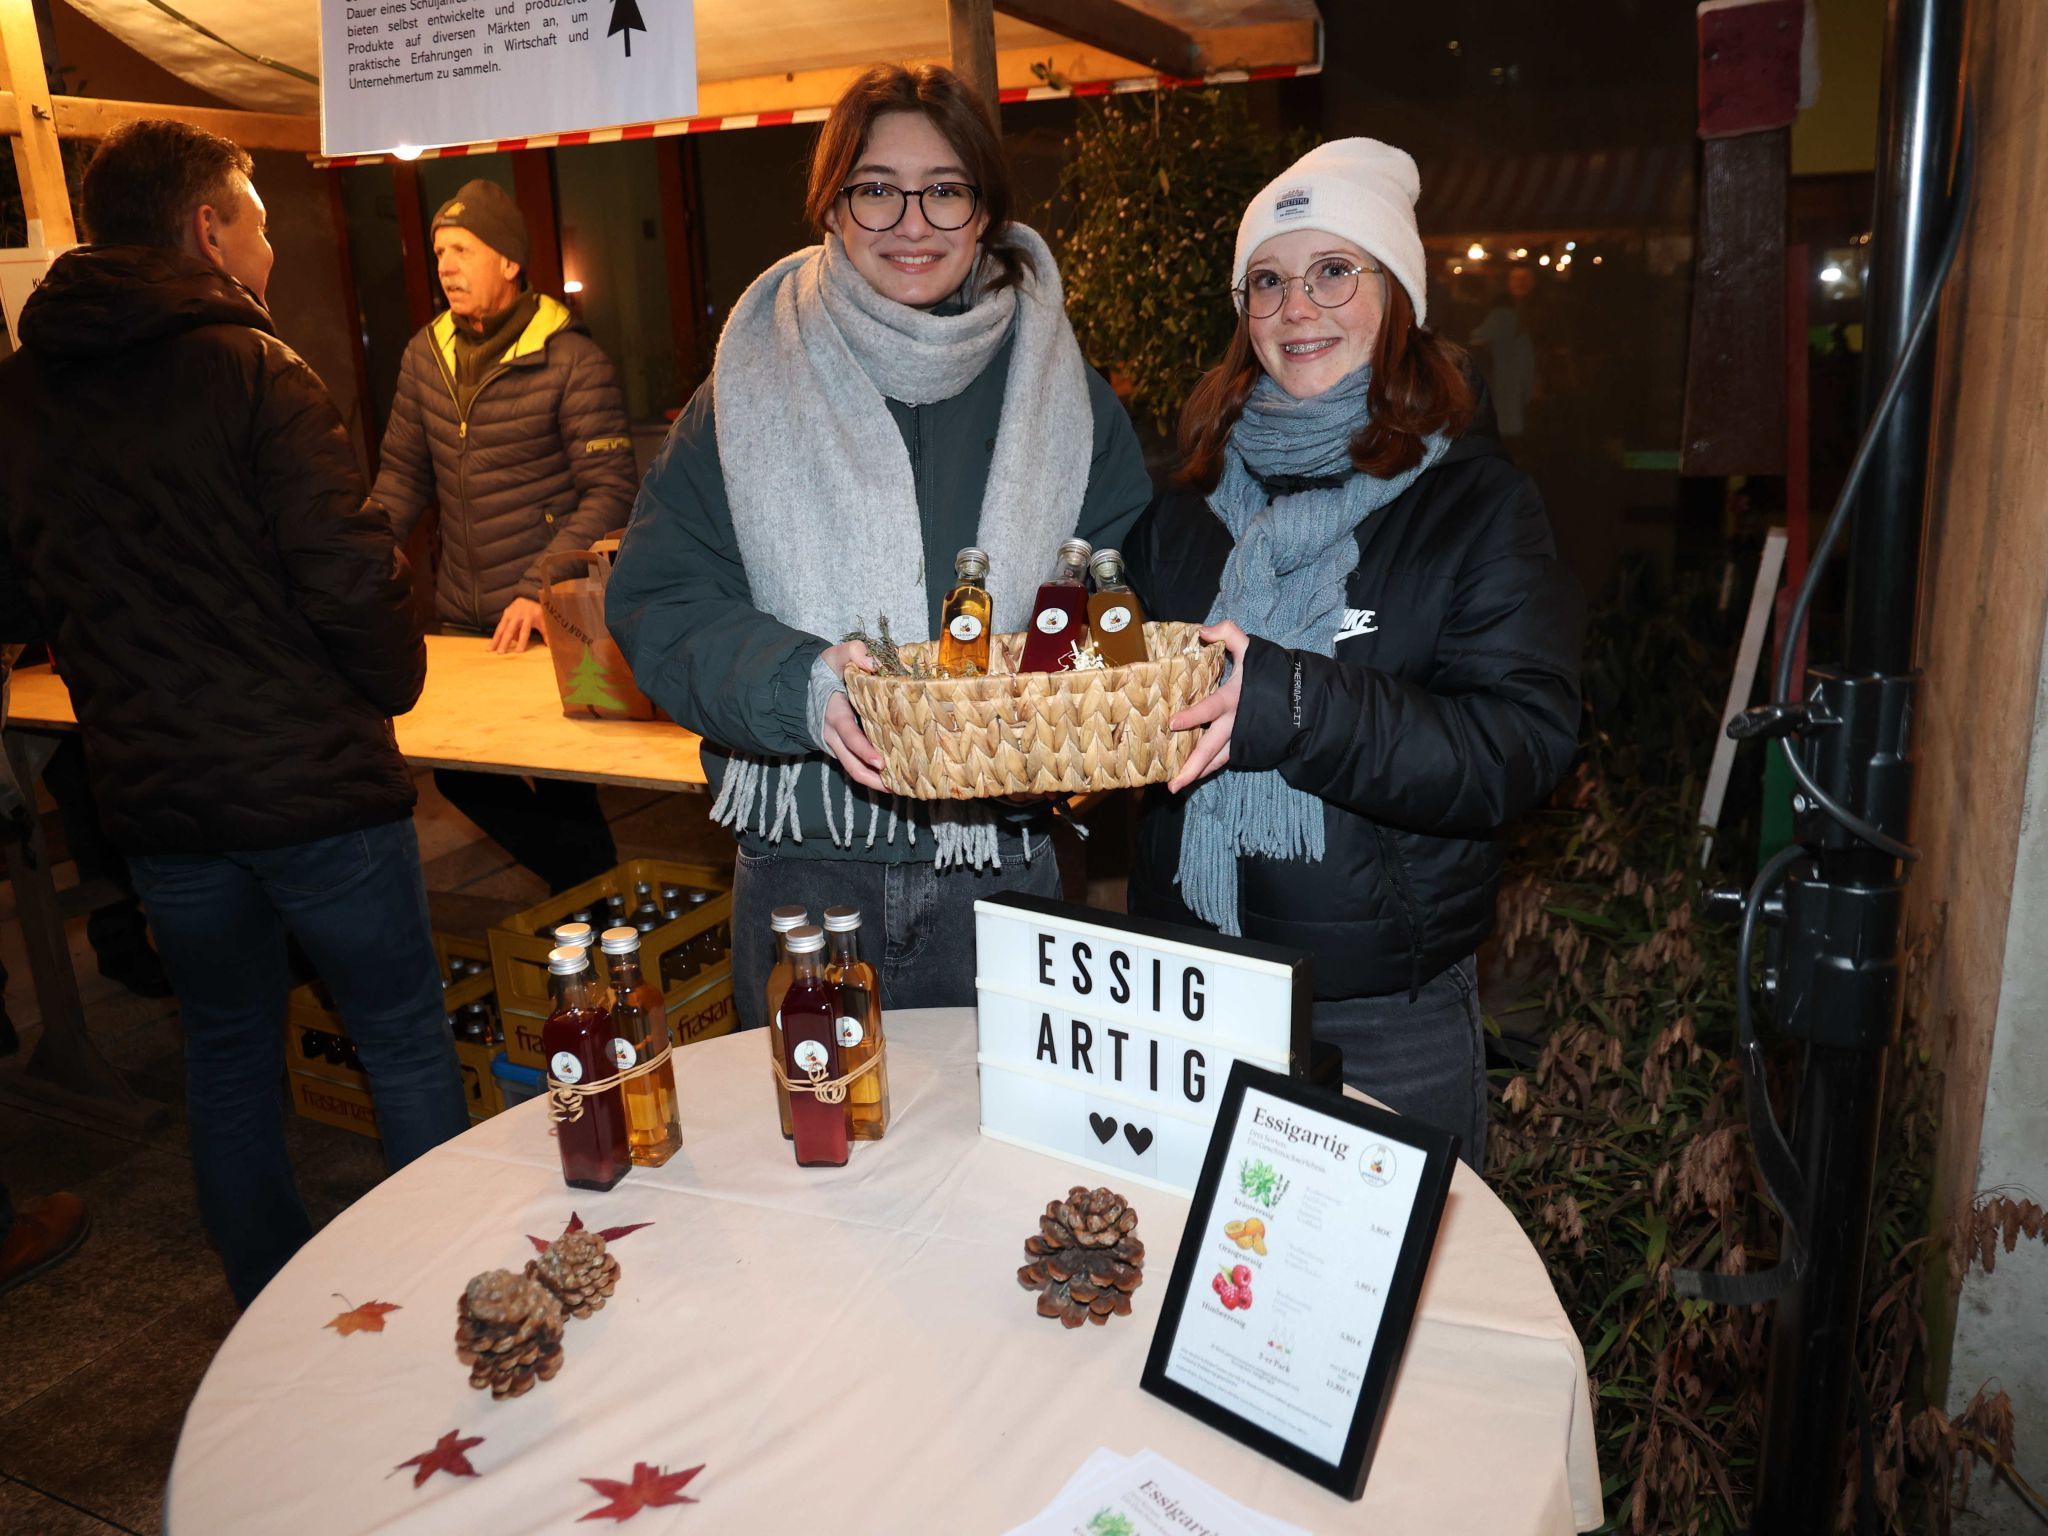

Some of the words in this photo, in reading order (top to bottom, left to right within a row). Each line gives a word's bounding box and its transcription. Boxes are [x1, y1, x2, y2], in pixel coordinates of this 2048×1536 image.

[346, 7, 377, 20] Dauer
[380, 3, 407, 15] eines
[347, 24, 379, 37] bieten
[388, 17, 418, 32] selbst
[427, 8, 486, 26] entwickelte
[495, 3, 515, 17] und
[348, 39, 394, 55] Produkte
[405, 35, 422, 48] auf
[432, 27, 476, 44] diversen
[488, 20, 531, 36] Märkten
[542, 16, 559, 29] an,
[571, 12, 589, 24] um
[349, 56, 401, 75] praktische
[411, 46, 473, 66] Erfahrungen
[484, 42, 494, 55] in
[504, 33, 558, 52] Wirtschaft
[568, 29, 589, 43] und
[349, 69, 434, 90] Unternehmertum
[437, 68, 450, 80] zu
[453, 60, 502, 78] sammeln.
[1292, 661, 1302, 729] THERMA-FIT
[1037, 932, 1206, 1022] ESSIG
[1036, 1012, 1206, 1103] ARTIG
[1253, 1106, 1350, 1162] Essigartig
[1273, 1358, 1291, 1373] Pack
